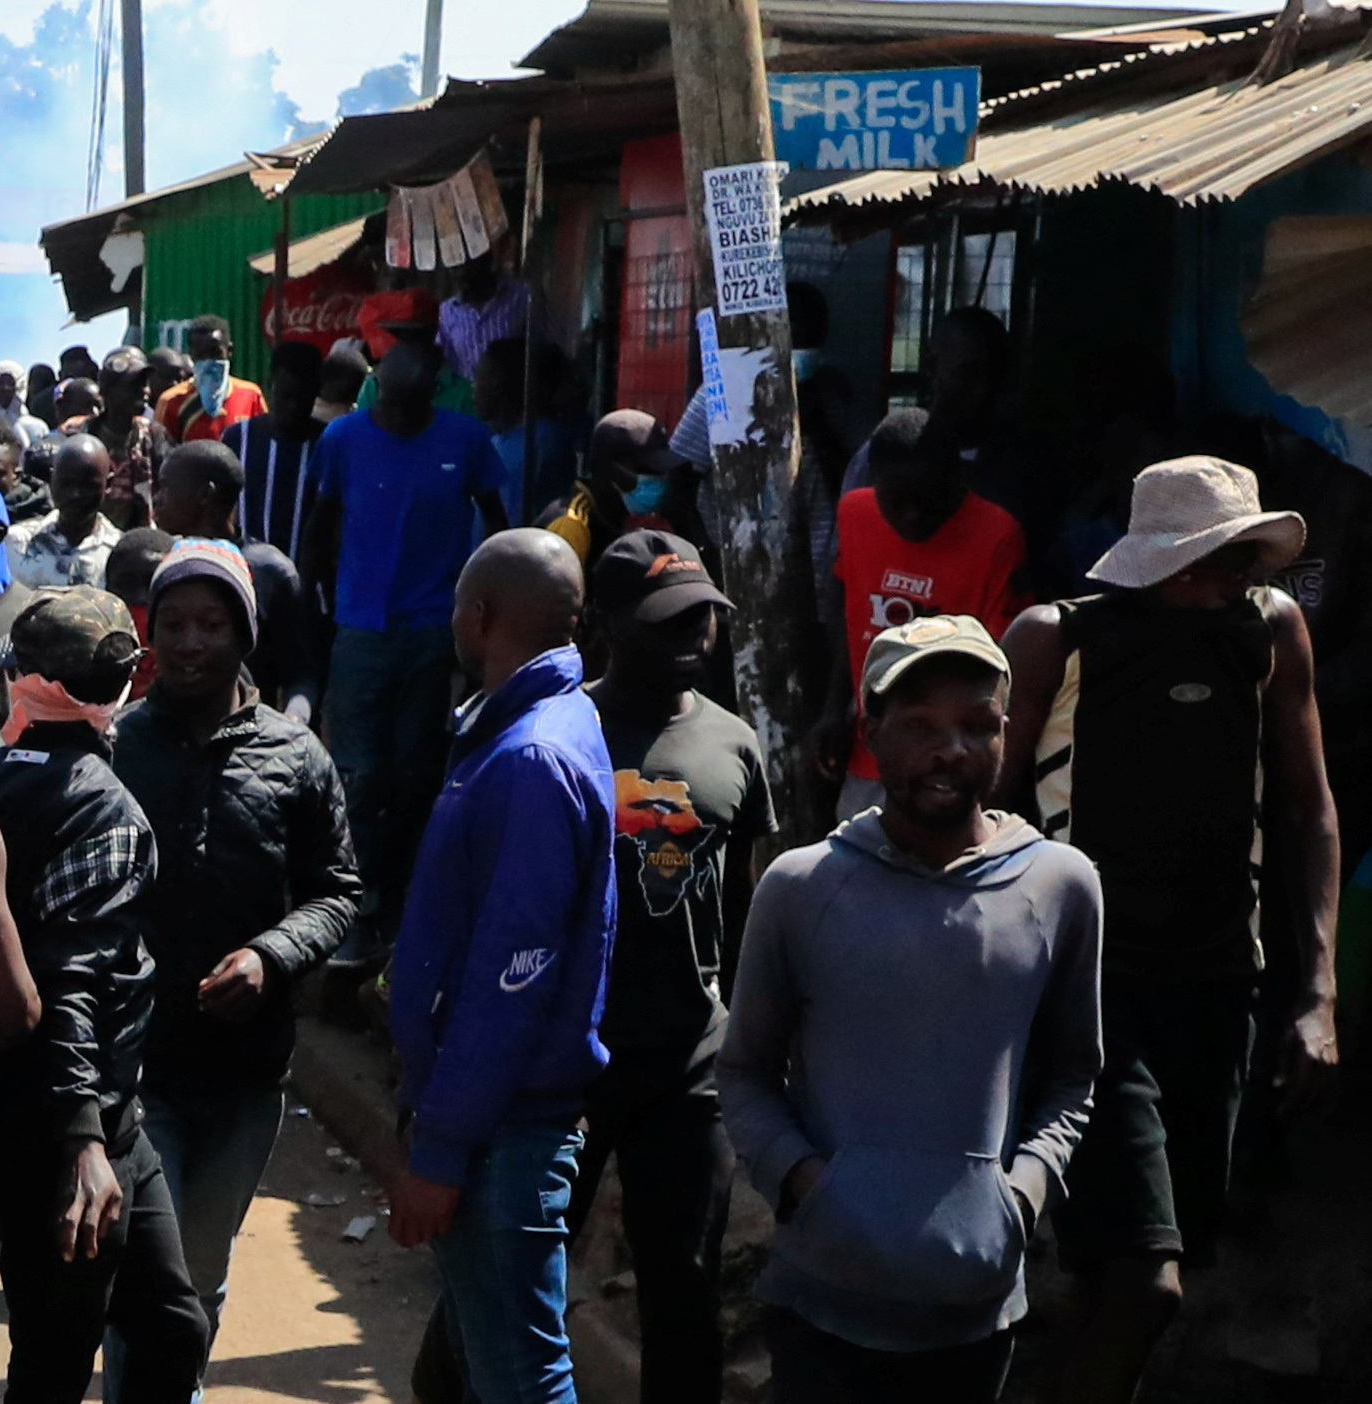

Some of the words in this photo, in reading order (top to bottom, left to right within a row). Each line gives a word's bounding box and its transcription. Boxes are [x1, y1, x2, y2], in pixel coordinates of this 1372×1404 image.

[781, 79, 966, 135] FRESH
[816, 130, 940, 170] MILK
[709, 170, 753, 187] OMARI
[722, 279, 759, 302] 0722
[509, 948, 547, 976] NIKE
